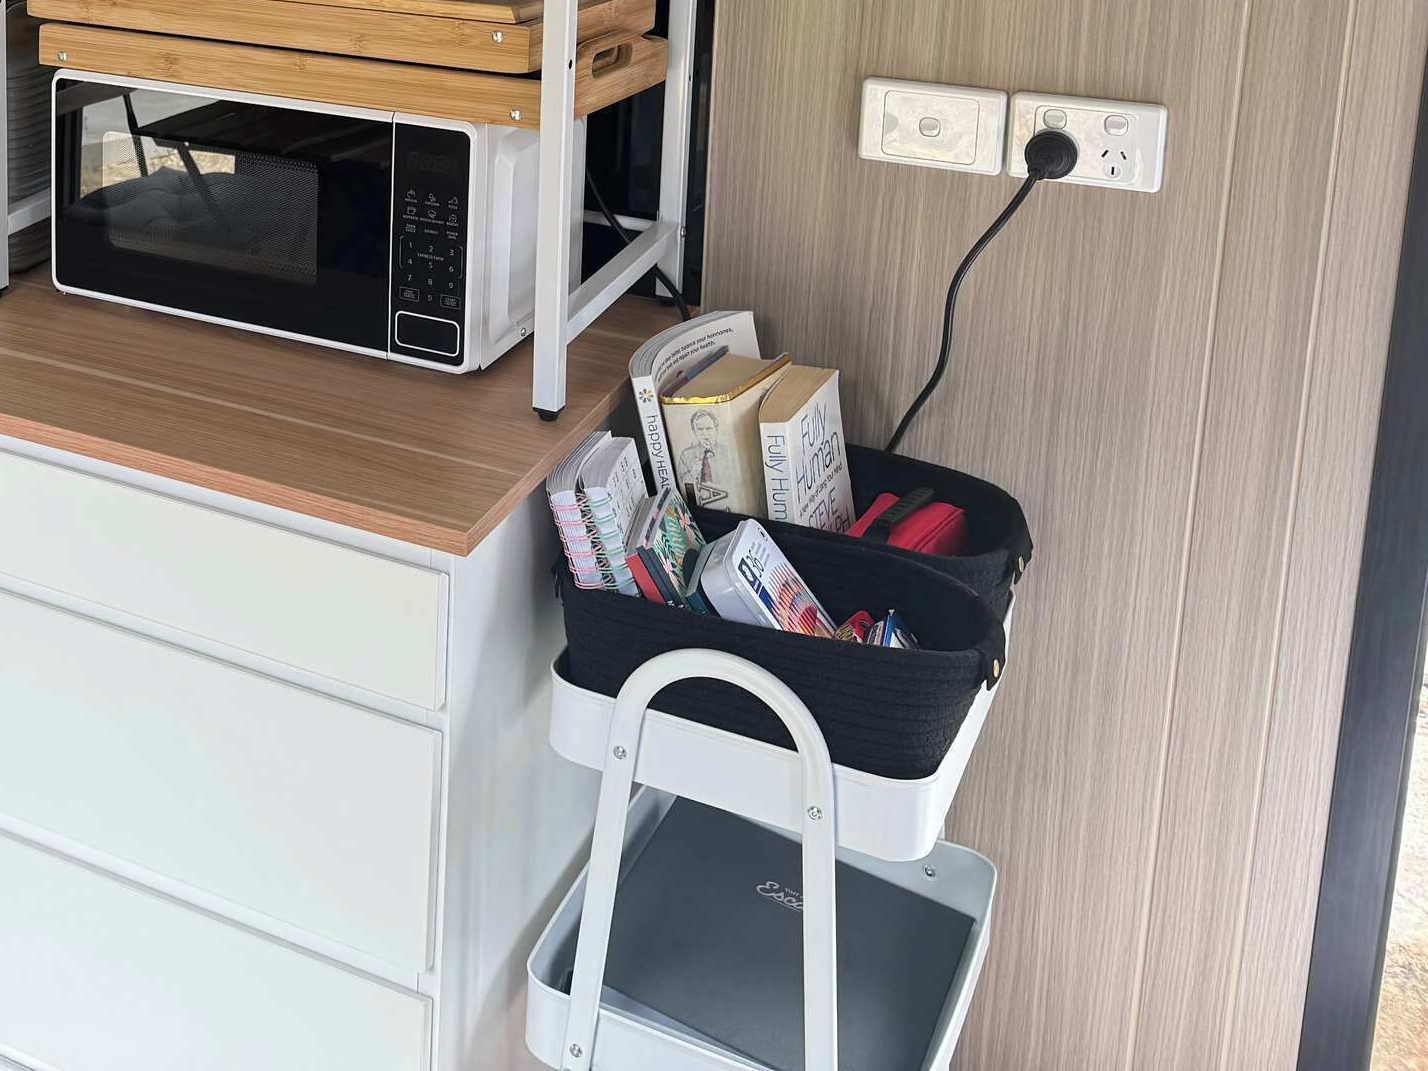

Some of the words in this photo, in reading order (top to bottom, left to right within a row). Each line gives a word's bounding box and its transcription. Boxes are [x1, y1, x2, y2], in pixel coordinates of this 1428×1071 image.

[645, 414, 664, 460] happy
[801, 403, 827, 456] Fully
[765, 435, 787, 473] Fully
[795, 431, 841, 504] Human
[745, 549, 765, 578] 36
